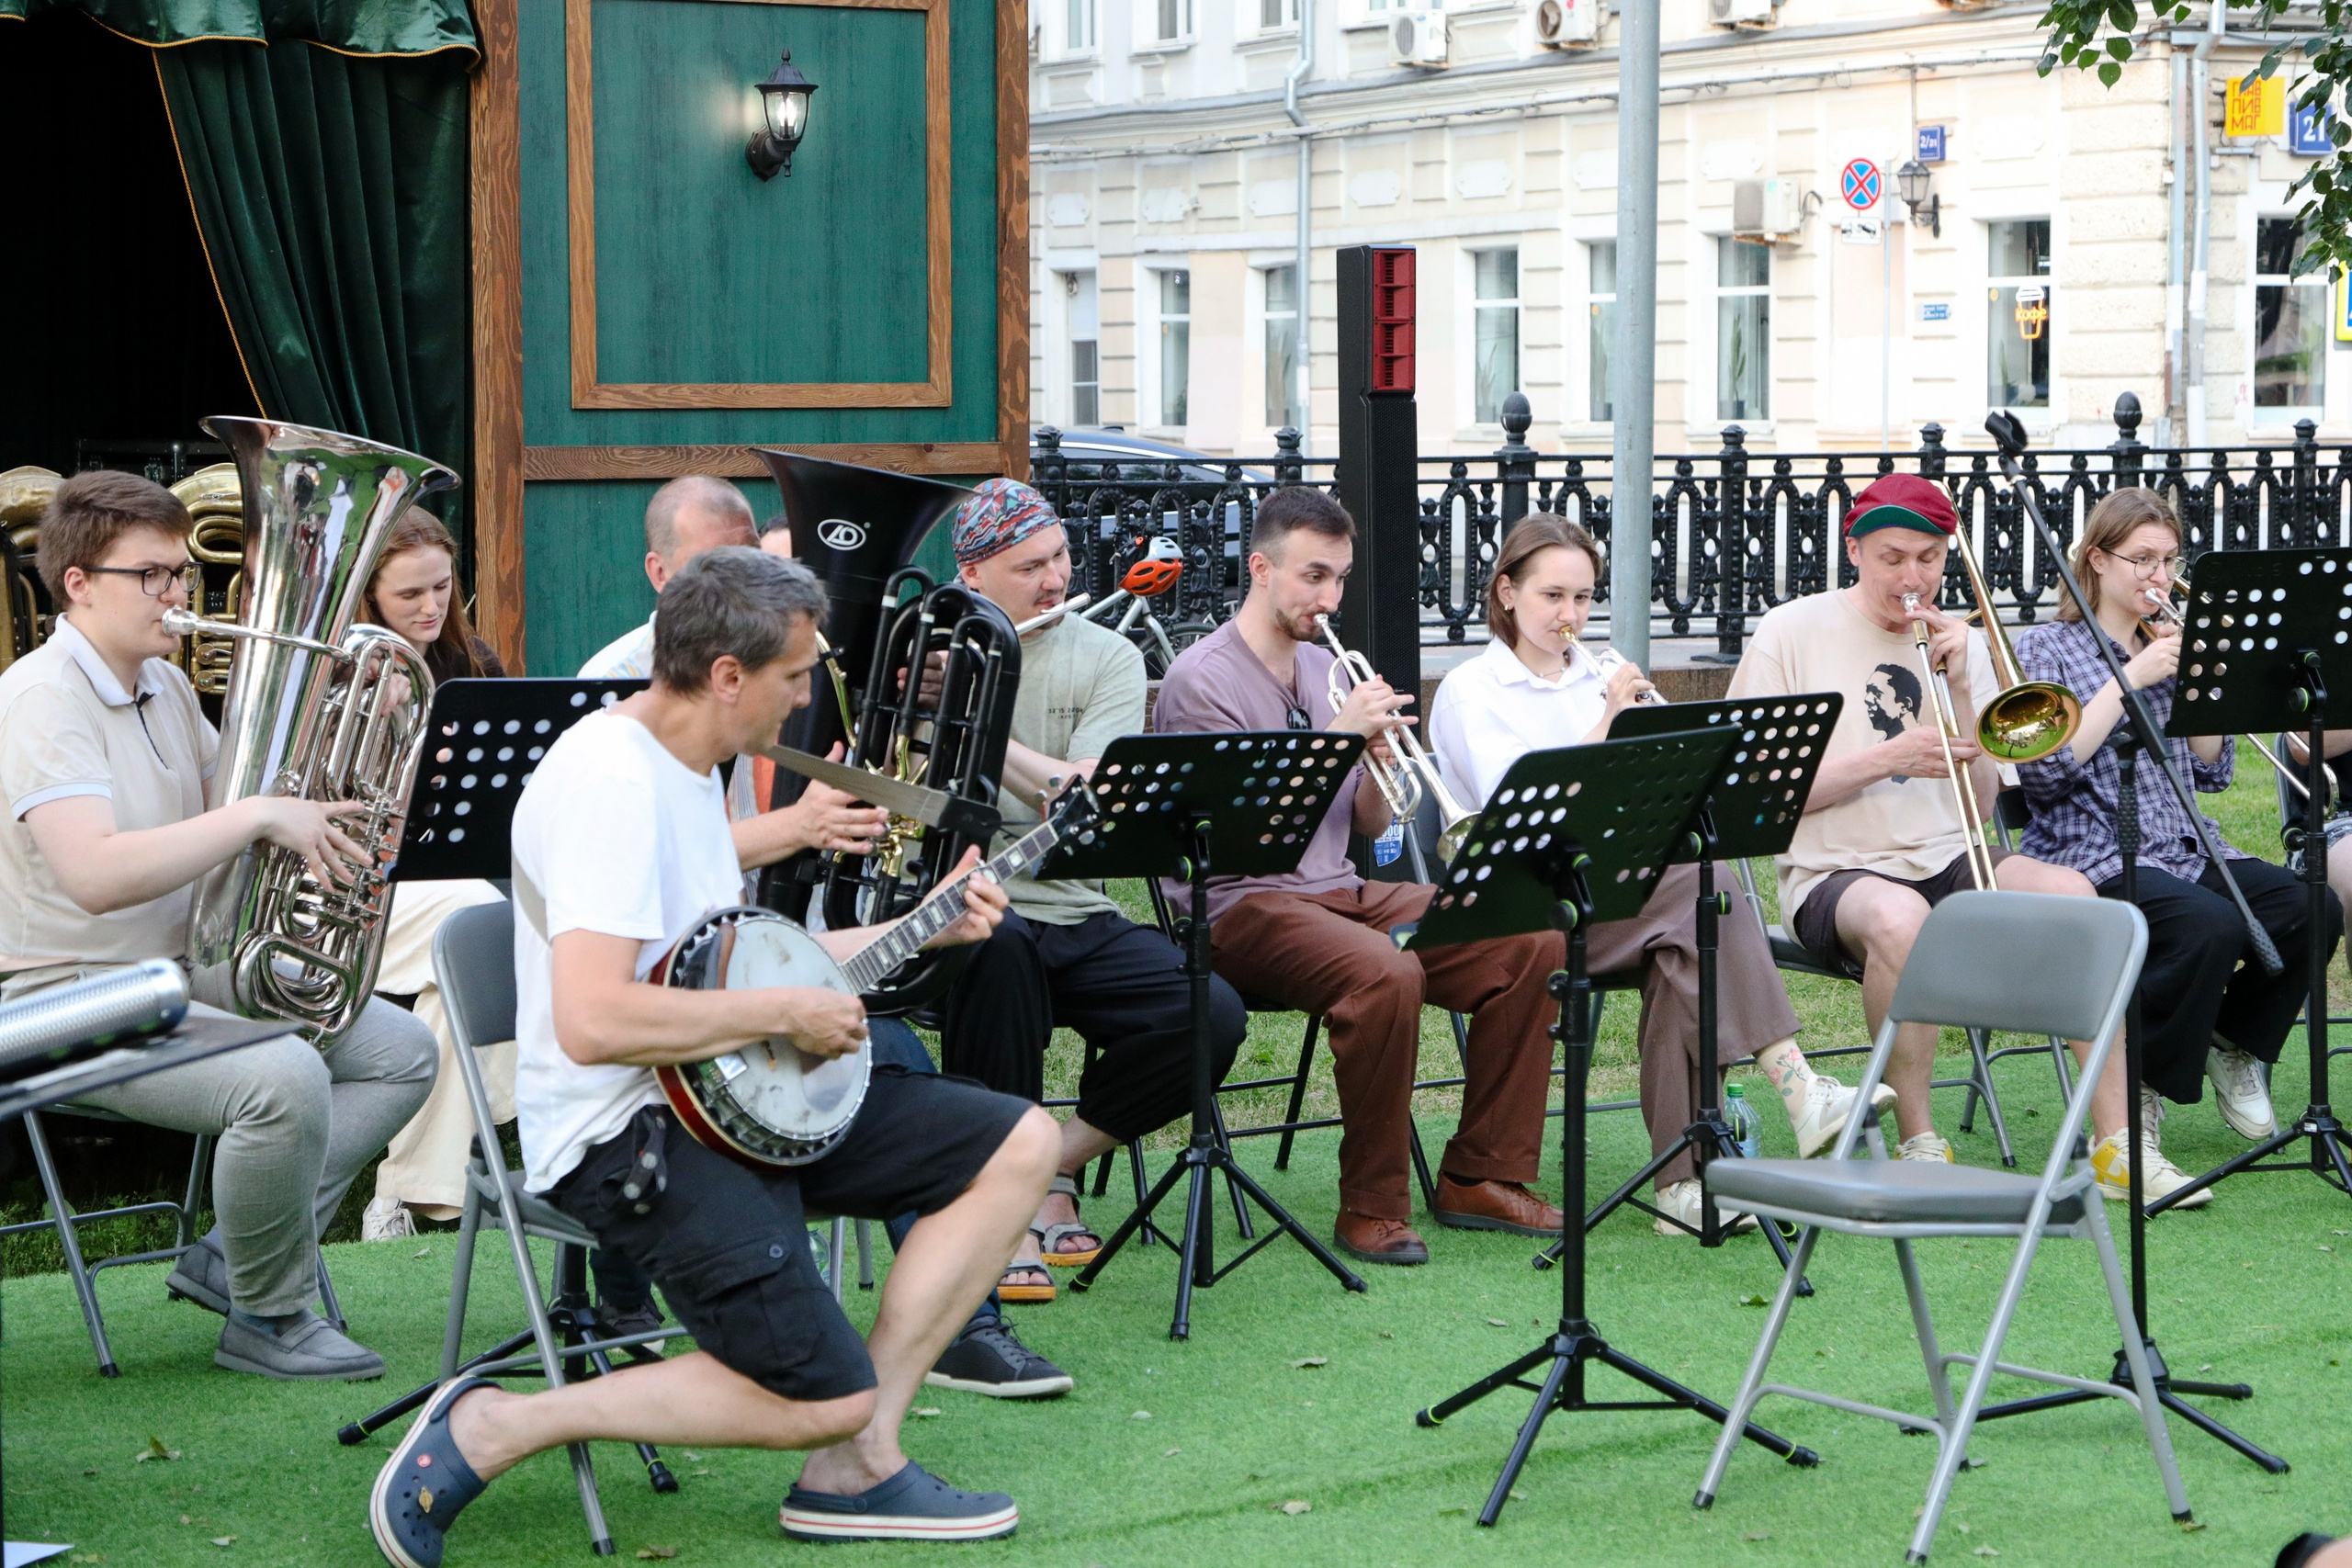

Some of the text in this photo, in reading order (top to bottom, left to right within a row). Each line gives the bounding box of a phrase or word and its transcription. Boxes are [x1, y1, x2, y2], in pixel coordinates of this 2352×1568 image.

[2232, 97, 2262, 115] ПИВ
[2231, 114, 2261, 131] МАГ
[2302, 115, 2325, 142] 21
